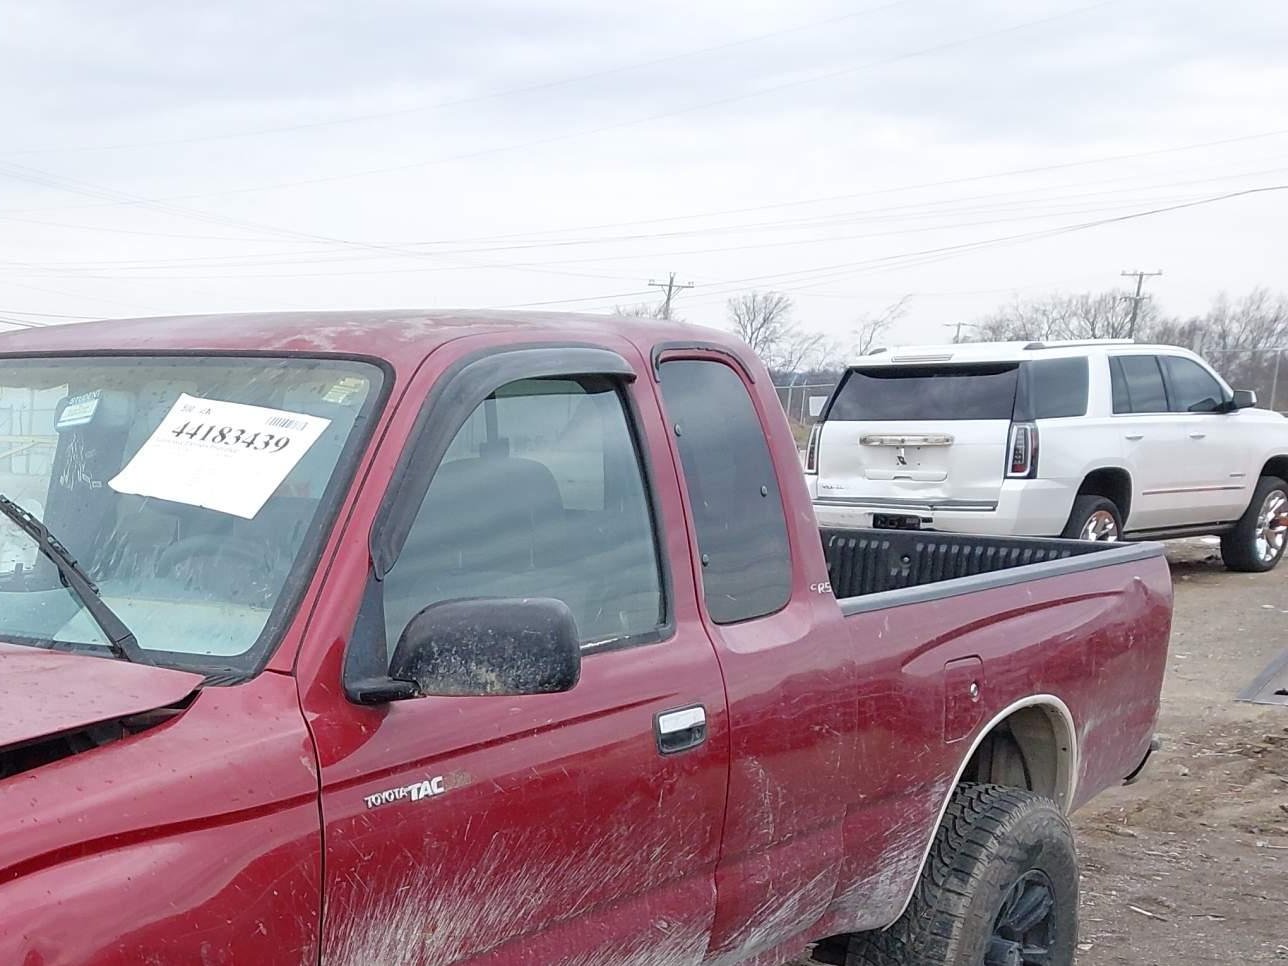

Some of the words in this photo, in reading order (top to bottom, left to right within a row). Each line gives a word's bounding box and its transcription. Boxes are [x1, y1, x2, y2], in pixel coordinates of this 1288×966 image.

[171, 420, 290, 454] 44183439
[364, 787, 407, 809] TOYOTA
[405, 775, 445, 802] TAC
